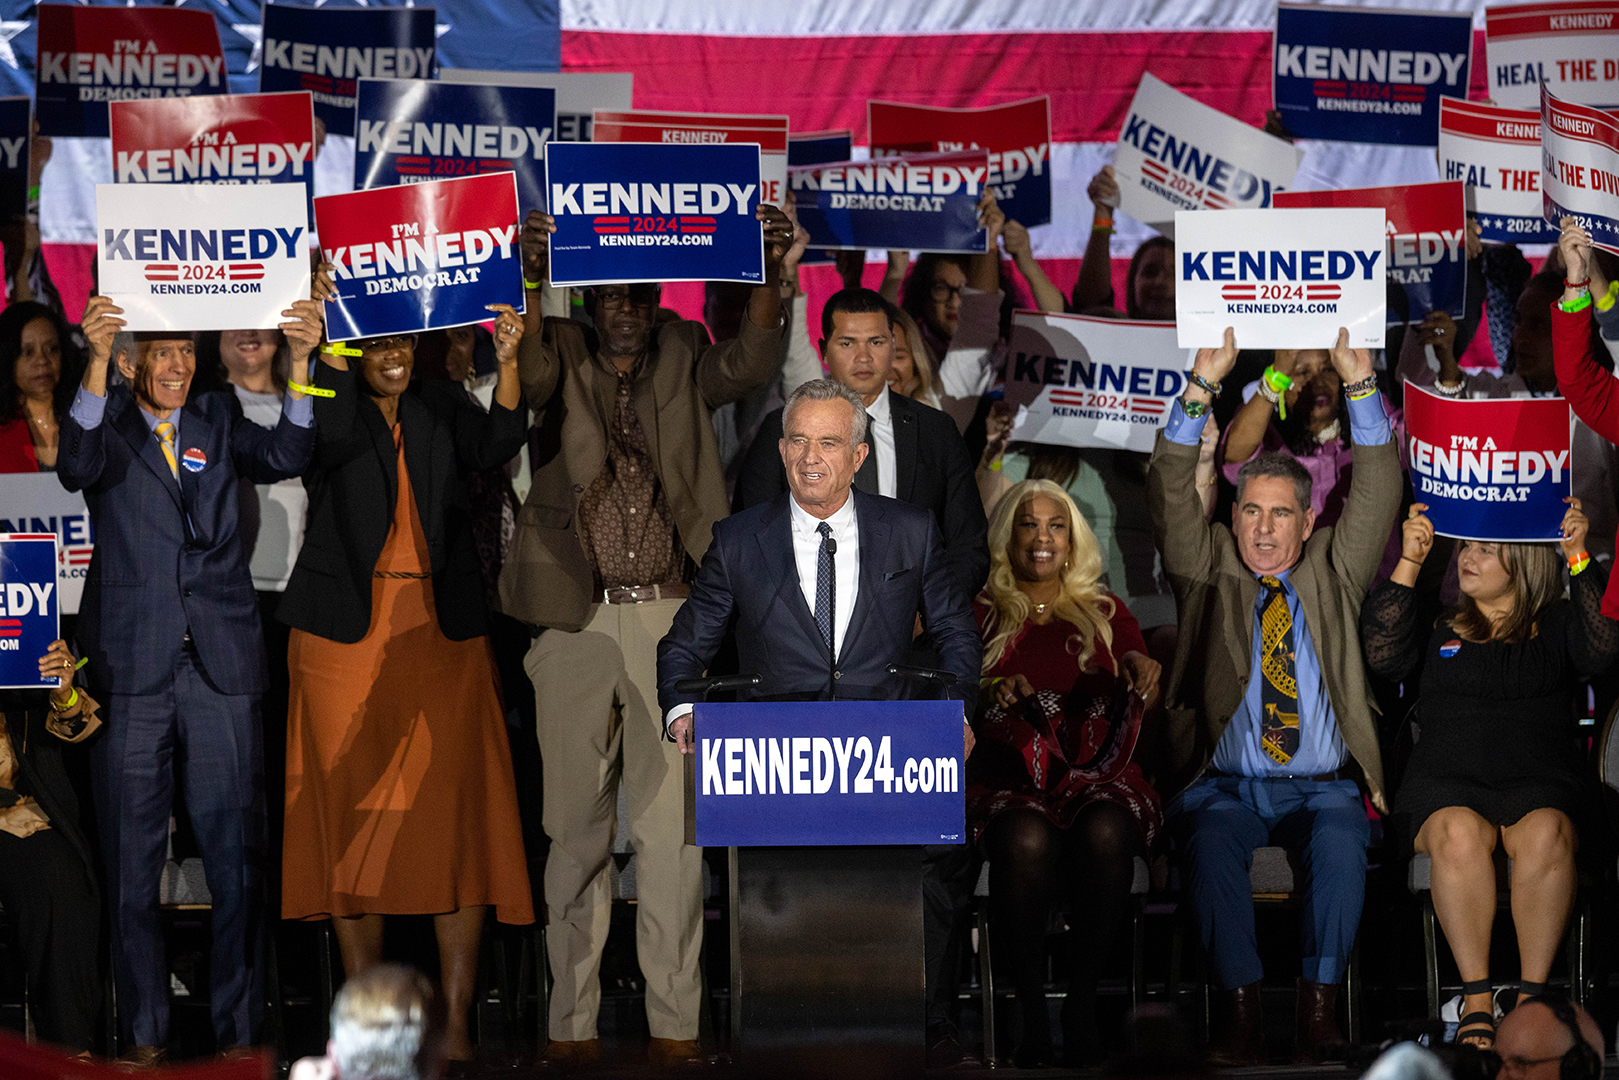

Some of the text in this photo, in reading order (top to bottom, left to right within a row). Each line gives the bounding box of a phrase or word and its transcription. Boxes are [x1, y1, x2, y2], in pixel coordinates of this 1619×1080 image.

[1550, 13, 1614, 30] KENNEDY
[113, 39, 159, 54] I'M A
[265, 38, 434, 80] KENNEDY
[1277, 44, 1466, 86] KENNEDY
[40, 52, 223, 87] KENNEDY
[1497, 61, 1550, 88] HEAL
[1556, 58, 1597, 82] THE
[78, 86, 191, 101] DEMOCRAT
[1350, 83, 1391, 99] 2024
[1317, 97, 1422, 116] KENNEDY24.COM
[1496, 122, 1542, 139] KENNE
[1552, 112, 1595, 136] KENNEDY
[191, 131, 238, 147] I'M A
[359, 119, 551, 161] KENNEDY
[662, 129, 728, 143] KENNEDY
[117, 142, 312, 183] KENNEDY
[433, 159, 477, 175] 2024
[792, 166, 987, 196] KENNEDY
[1446, 159, 1540, 192] HEAL THE
[1558, 160, 1586, 189] THE
[1169, 175, 1205, 200] 2024
[552, 183, 756, 216] KENNEDY
[830, 193, 946, 212] DEMOCRAT
[391, 222, 439, 238] I'M A
[633, 216, 678, 233] 2024
[1506, 218, 1541, 234] 2024
[104, 227, 304, 261] KENNEDY
[600, 235, 713, 247] KENNEDY24.COM
[324, 224, 517, 282] KENNEDY
[182, 264, 226, 281] 2024
[1182, 250, 1382, 281] KENNEDY
[151, 283, 261, 295] KENNEDY24.COM
[366, 267, 481, 296] DEMOCRAT
[1260, 284, 1304, 300] 2024
[1228, 303, 1337, 314] KENNEDY24.COM
[1086, 393, 1129, 410] 2024
[1052, 406, 1160, 426] KENNEDY24.COM
[1450, 435, 1498, 450] I'M A
[1421, 476, 1531, 502] DEMOCRAT
[702, 735, 959, 796] KENNEDY24.com
